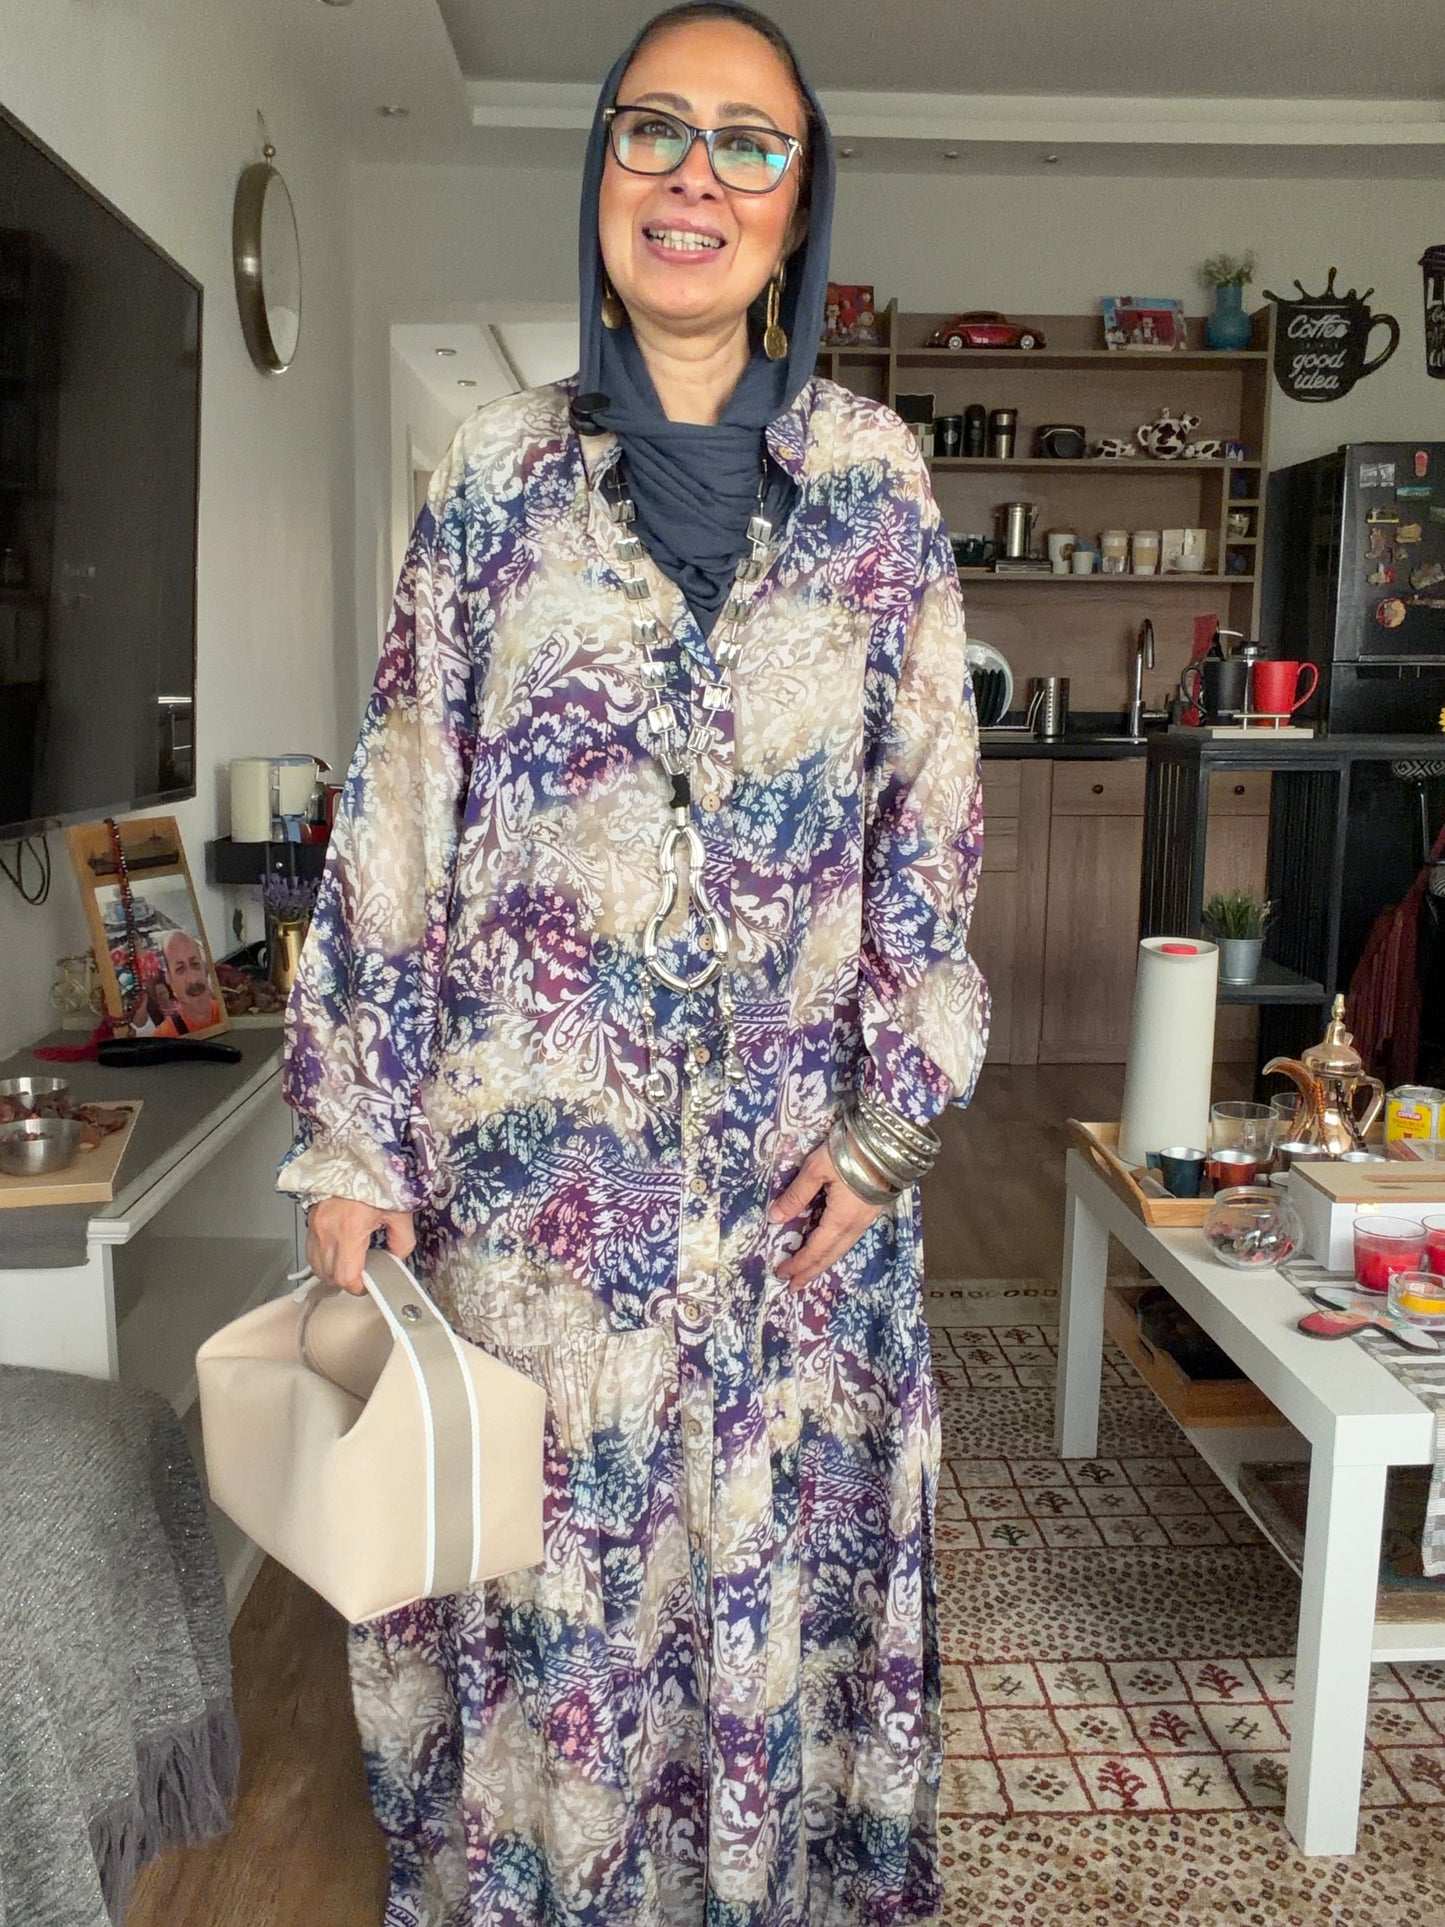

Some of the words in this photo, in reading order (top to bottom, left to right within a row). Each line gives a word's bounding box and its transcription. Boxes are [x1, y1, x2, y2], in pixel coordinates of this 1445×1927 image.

[1287, 314, 1351, 339] Coffee
[1288, 348, 1348, 378] good
[1293, 369, 1340, 390] idea
